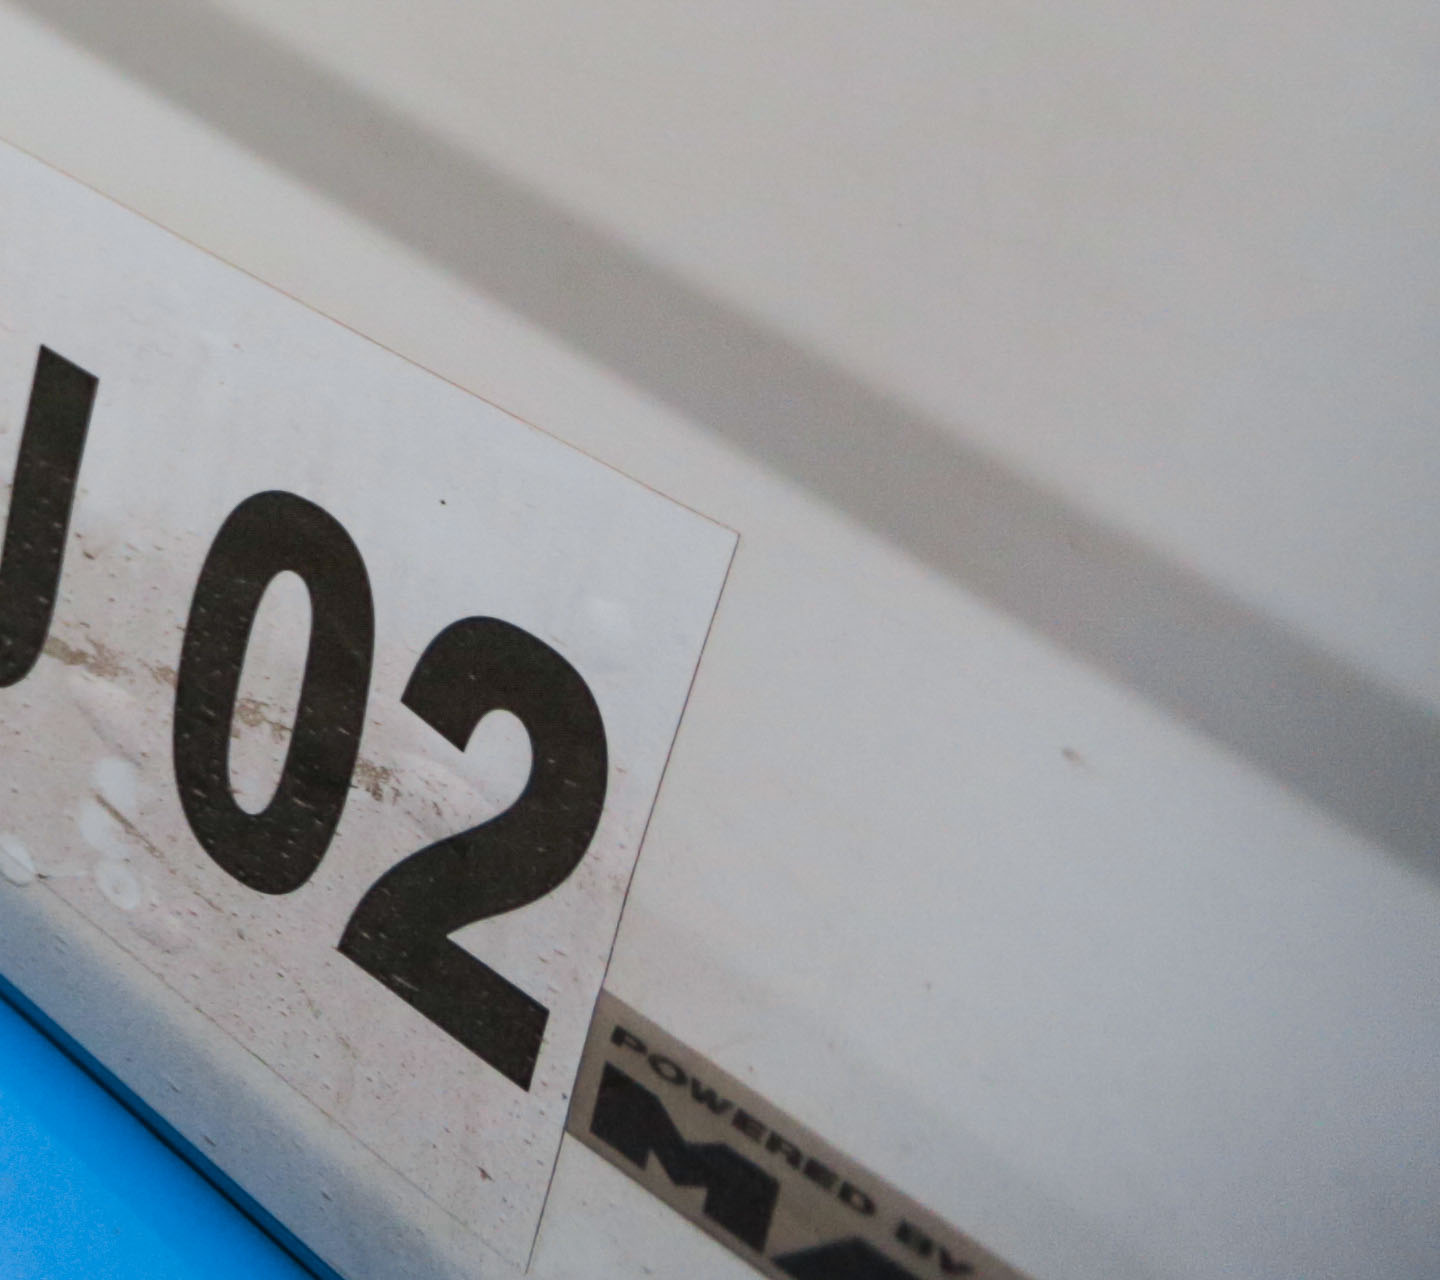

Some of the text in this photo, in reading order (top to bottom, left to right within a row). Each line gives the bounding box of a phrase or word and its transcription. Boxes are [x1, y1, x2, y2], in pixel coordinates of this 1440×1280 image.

[172, 488, 610, 1094] 02
[609, 1023, 975, 1276] POWERED BY
